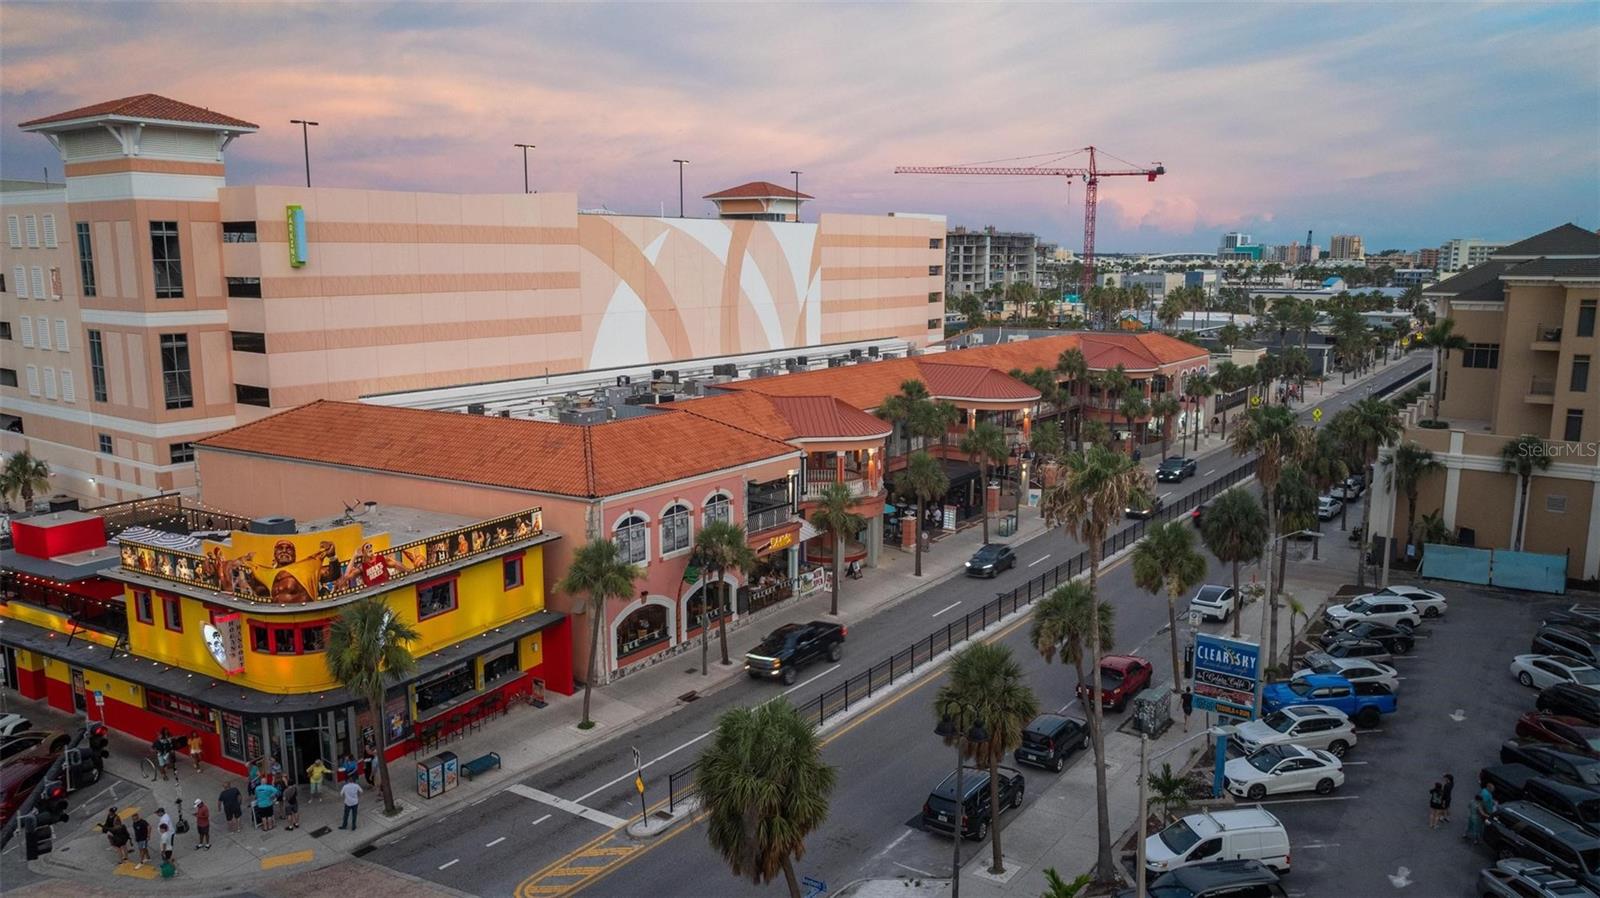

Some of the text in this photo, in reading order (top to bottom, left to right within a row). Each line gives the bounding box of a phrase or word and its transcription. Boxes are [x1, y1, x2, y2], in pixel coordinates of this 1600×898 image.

[288, 209, 296, 264] PARKING
[1197, 646, 1229, 665] CLEAR
[1235, 653, 1256, 669] SKY
